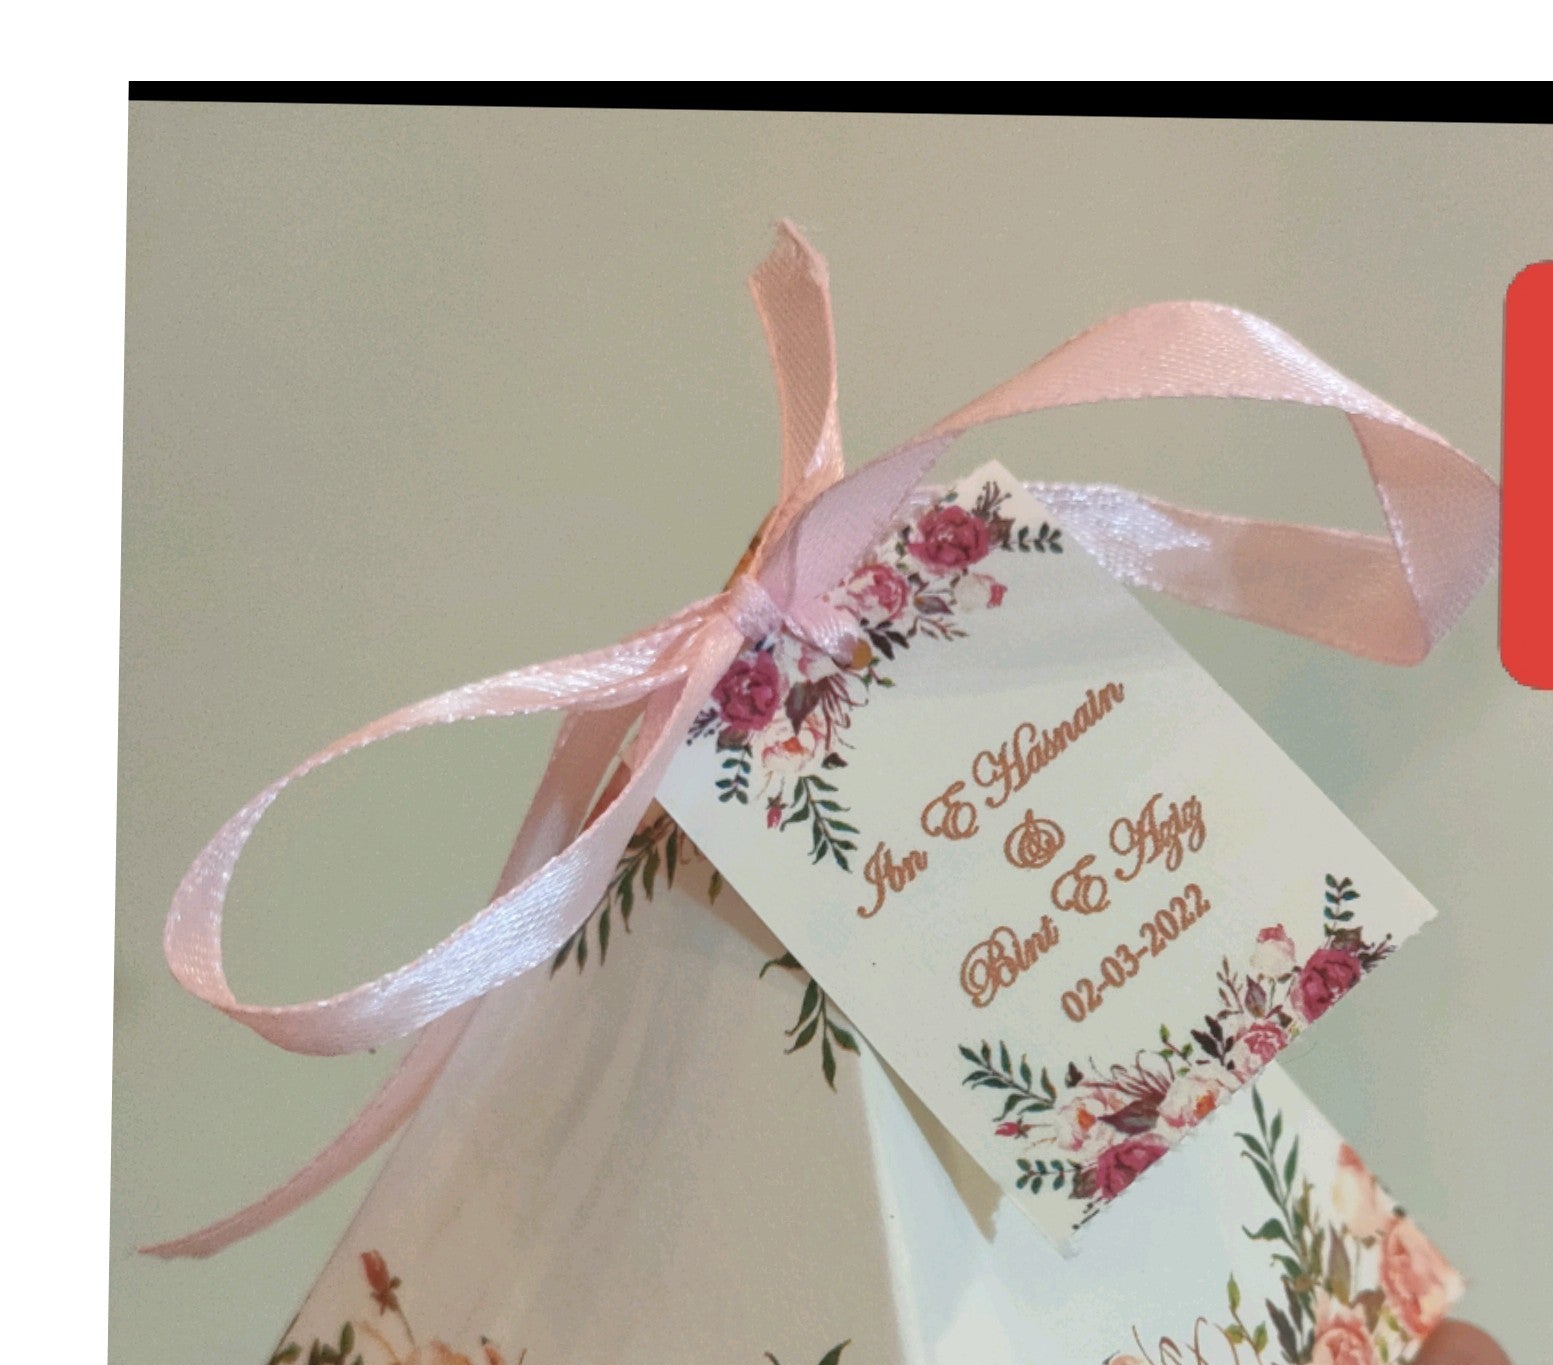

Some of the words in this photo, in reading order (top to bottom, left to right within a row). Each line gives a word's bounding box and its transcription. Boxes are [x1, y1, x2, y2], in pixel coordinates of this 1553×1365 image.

[856, 841, 928, 919] Ibn
[920, 780, 980, 841] E
[972, 682, 1125, 808] Hasnain
[960, 914, 1060, 1008] Bint
[1050, 853, 1111, 914] E
[1109, 792, 1207, 882] Aziz
[1060, 883, 1211, 1023] 02-03-2022
